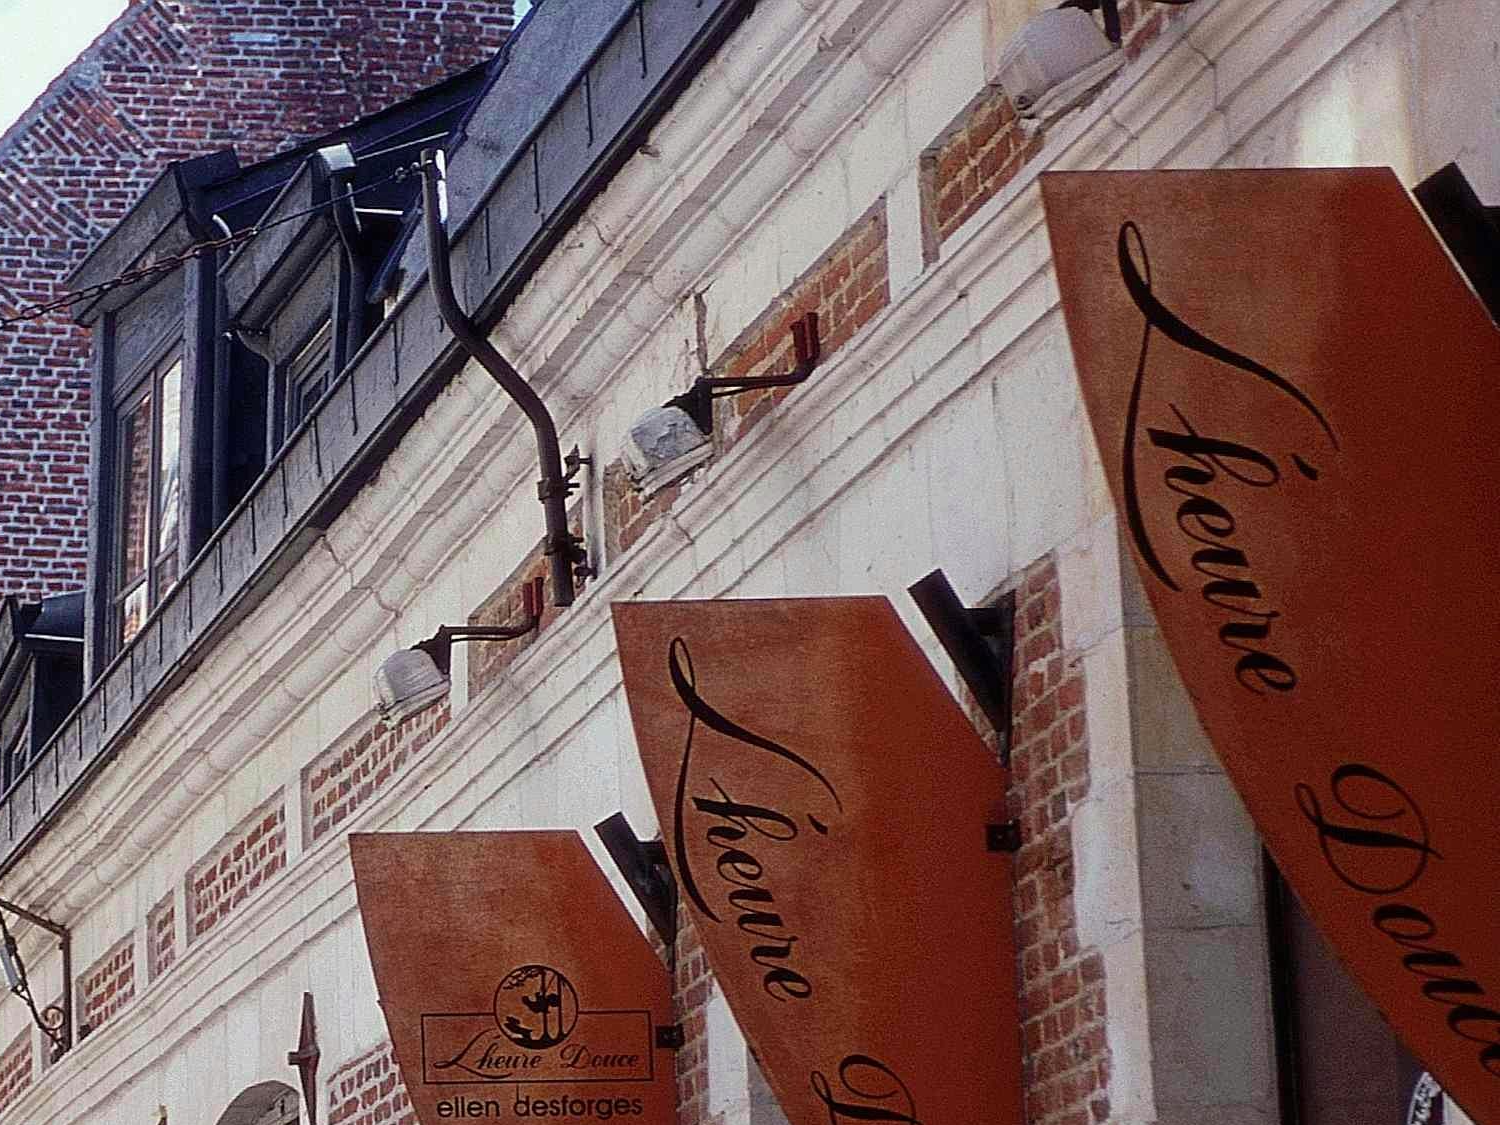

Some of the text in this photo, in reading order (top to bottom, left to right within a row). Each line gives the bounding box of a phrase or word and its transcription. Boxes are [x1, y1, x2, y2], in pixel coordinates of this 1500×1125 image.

[1118, 221, 1340, 696] L'heure
[669, 637, 843, 1001] L'heure
[433, 1026, 639, 1079] L'heure Douce
[437, 1086, 643, 1119] ellen desforges
